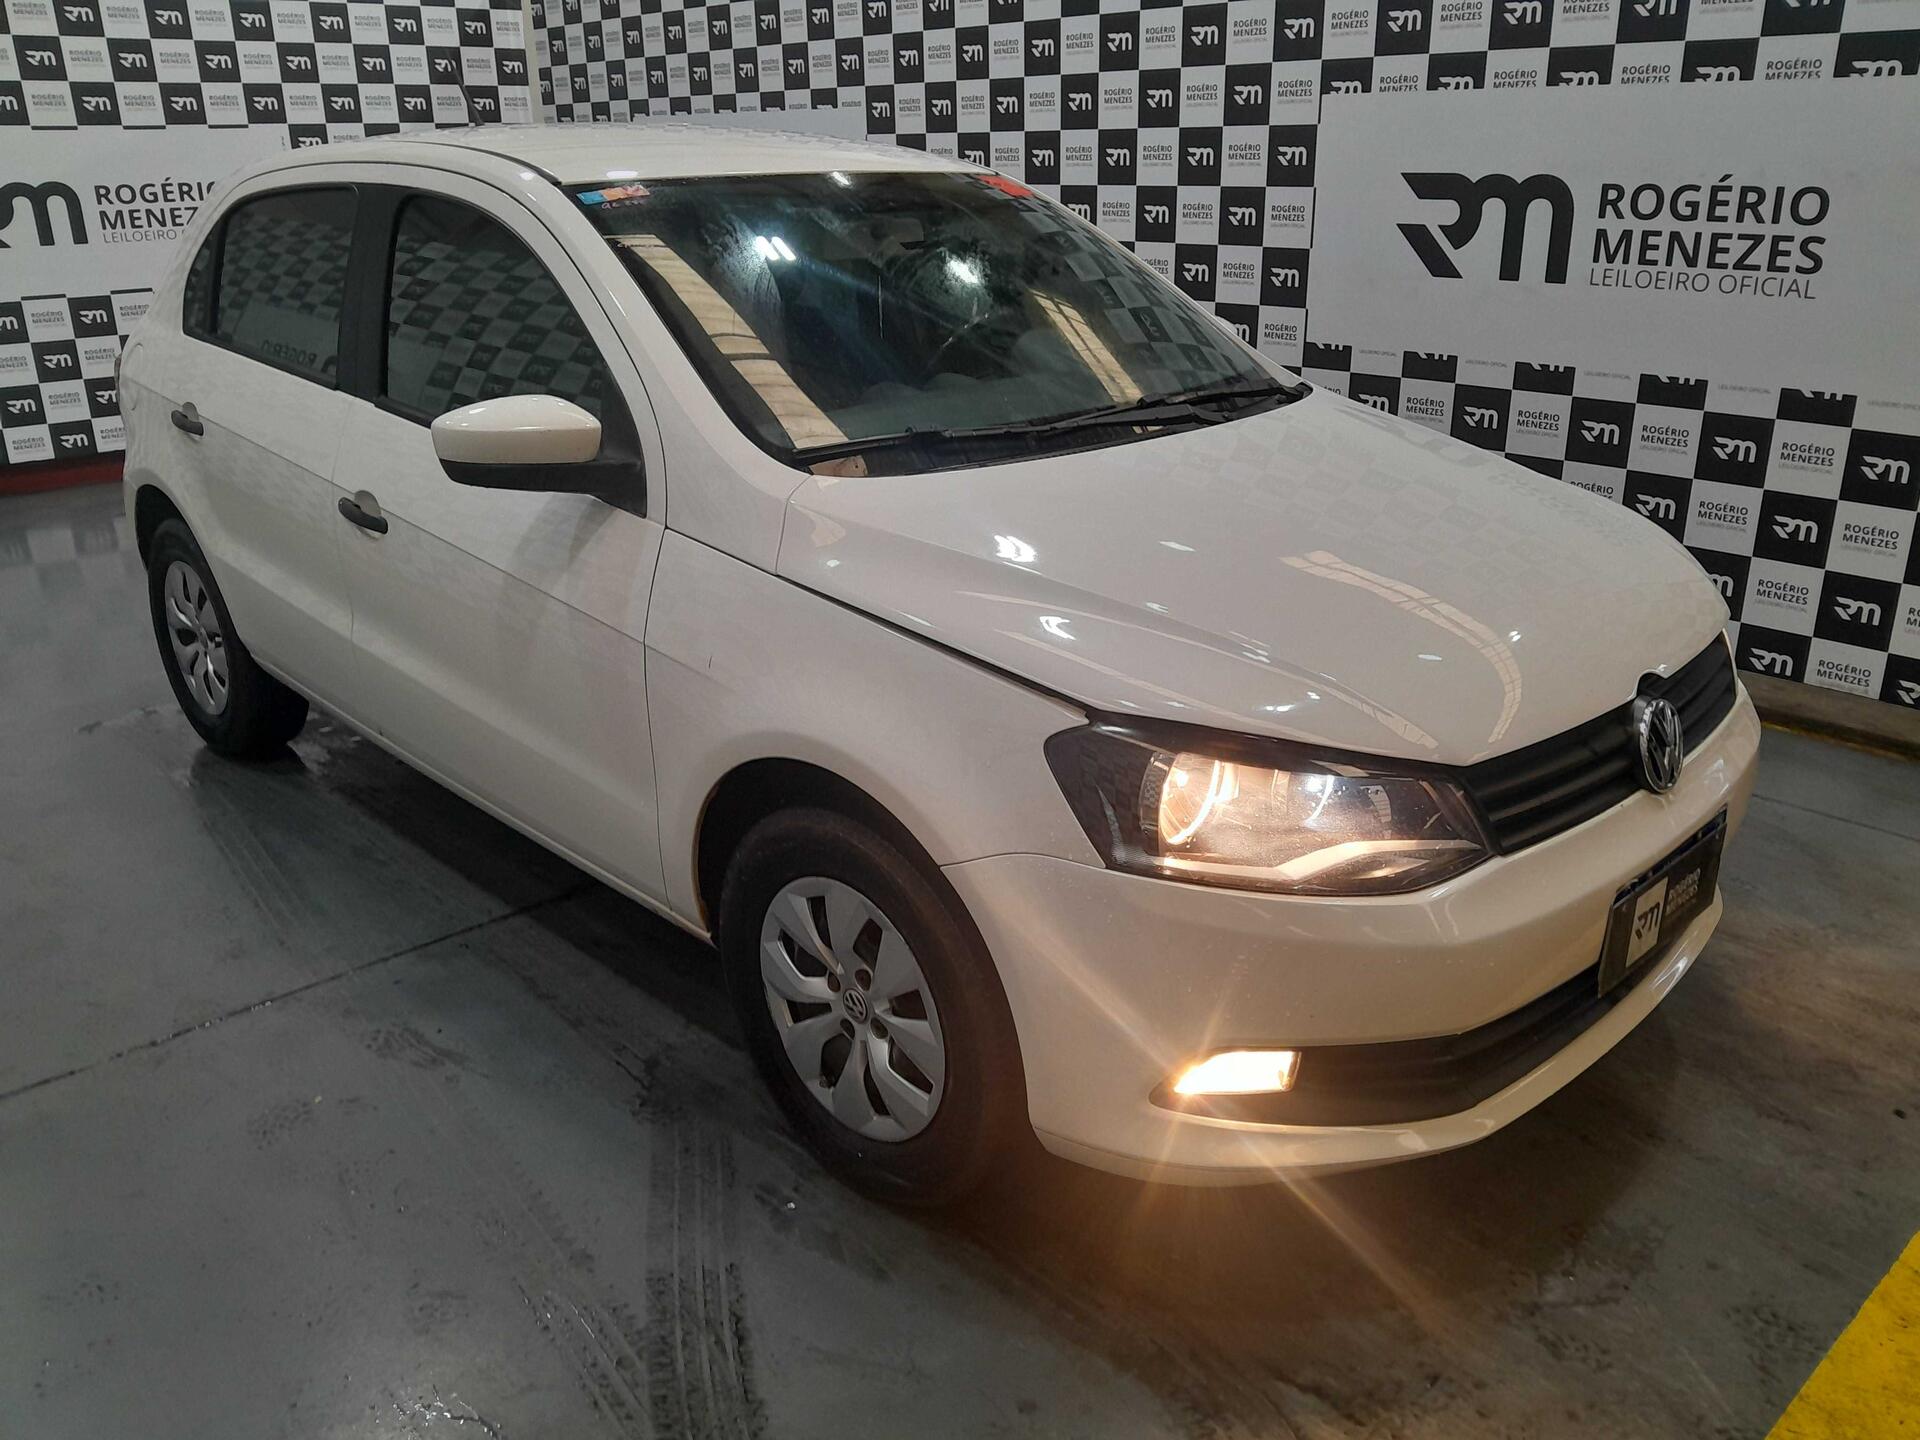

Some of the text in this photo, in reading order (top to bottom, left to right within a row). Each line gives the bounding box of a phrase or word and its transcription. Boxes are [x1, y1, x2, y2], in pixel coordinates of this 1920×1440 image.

[1441, 1, 1483, 12] ROGÉRIO
[1563, 2, 1609, 14] MENEZES
[1331, 10, 1368, 21] ROGÉRIO
[1440, 11, 1482, 21] MENEZES
[1233, 18, 1267, 28] ROGÉRIO
[1331, 20, 1368, 29] MENEZES
[1146, 26, 1175, 35] ROGÉRIO
[1233, 27, 1267, 37] MENEZES
[1146, 35, 1175, 43] MENEZES
[1622, 64, 1671, 75] ROGÉRIO
[1767, 59, 1822, 70] ROGÉRIO
[1380, 74, 1418, 84] ROGÉRIO
[1494, 69, 1537, 80] ROGÉRIO
[1186, 84, 1217, 93] ROGÉRIO
[1278, 80, 1312, 90] ROGÉRIO
[1187, 93, 1217, 101] MENEZES
[1278, 88, 1312, 97] MENEZES
[1228, 143, 1260, 153] ROGÉRIO
[1228, 152, 1260, 160] MENEZES
[1103, 201, 1130, 209] ROGÉRIO
[1598, 174, 1830, 226] ROGÉRIO
[1183, 203, 1213, 212] ROGÉRIO
[1272, 204, 1305, 213] ROGÉRIO
[1103, 209, 1130, 217] MENEZES
[1183, 211, 1213, 219] MENEZES
[1271, 213, 1304, 222] MENEZES
[103, 230, 177, 243] LEILOEIRO
[1592, 229, 1826, 275] MENEZES
[1223, 263, 1254, 271] ROGÉRIO
[1223, 270, 1254, 279] MENEZES
[1590, 269, 1816, 299] LEILOEIRO OFICIAL
[1265, 323, 1297, 332] ROGÉRIO
[1264, 331, 1297, 341] MENEZES
[1406, 396, 1444, 408] ROGÉRIO
[1406, 406, 1444, 416] MENEZES
[1518, 410, 1560, 422] ROGÉRIO
[1517, 420, 1560, 430] MENEZES
[1642, 425, 1689, 438] ROGÉRIO
[1640, 434, 1688, 448] MENEZES
[1782, 442, 1834, 456] ROGÉRIO
[1780, 452, 1834, 466] MENEZES
[1700, 501, 1748, 515] ROGÉRIO
[1698, 510, 1748, 526] MENEZES
[1845, 523, 1899, 539] ROGÉRIO
[1843, 533, 1898, 550] MENEZES
[1758, 579, 1809, 595] ROGÉRIO
[1757, 589, 1808, 605] MENEZES
[1818, 659, 1871, 677] ROGÉRIO
[1817, 668, 1870, 687] MENEZES
